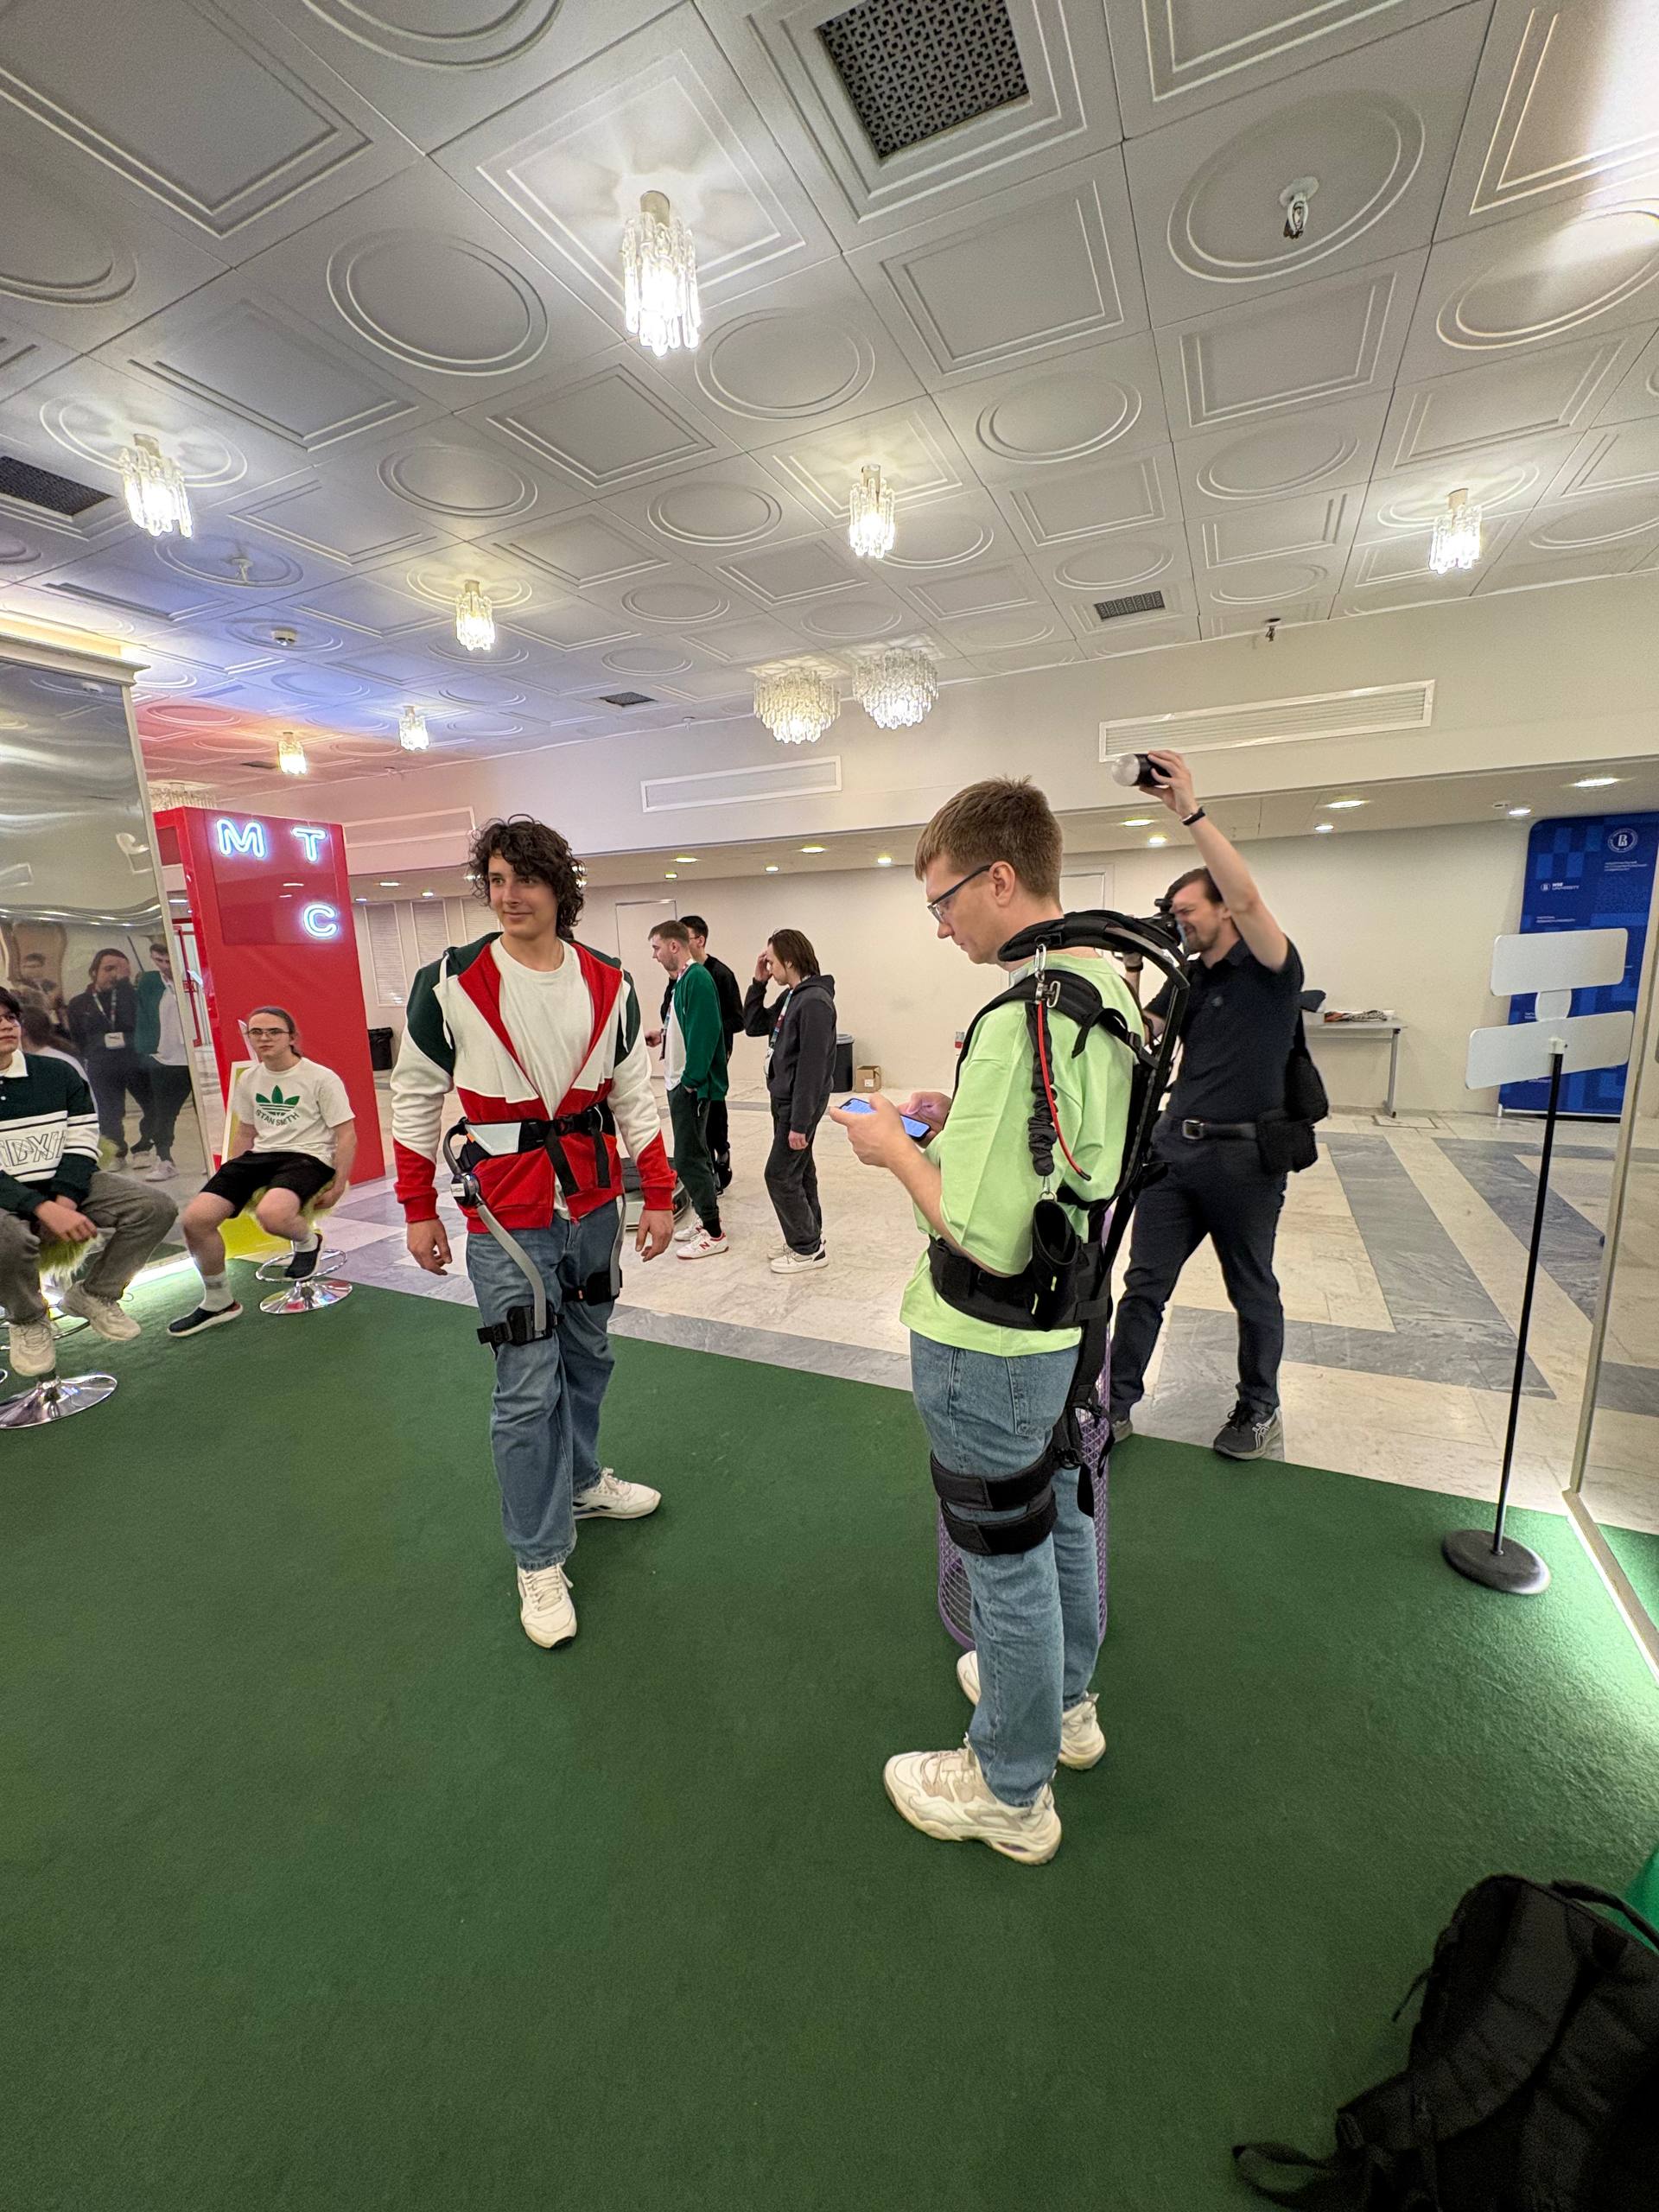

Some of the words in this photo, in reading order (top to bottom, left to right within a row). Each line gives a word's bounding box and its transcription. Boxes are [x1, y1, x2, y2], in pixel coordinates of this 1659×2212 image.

[255, 1109, 276, 1125] STAN
[276, 1111, 301, 1126] SMITH
[699, 1241, 710, 1249] N
